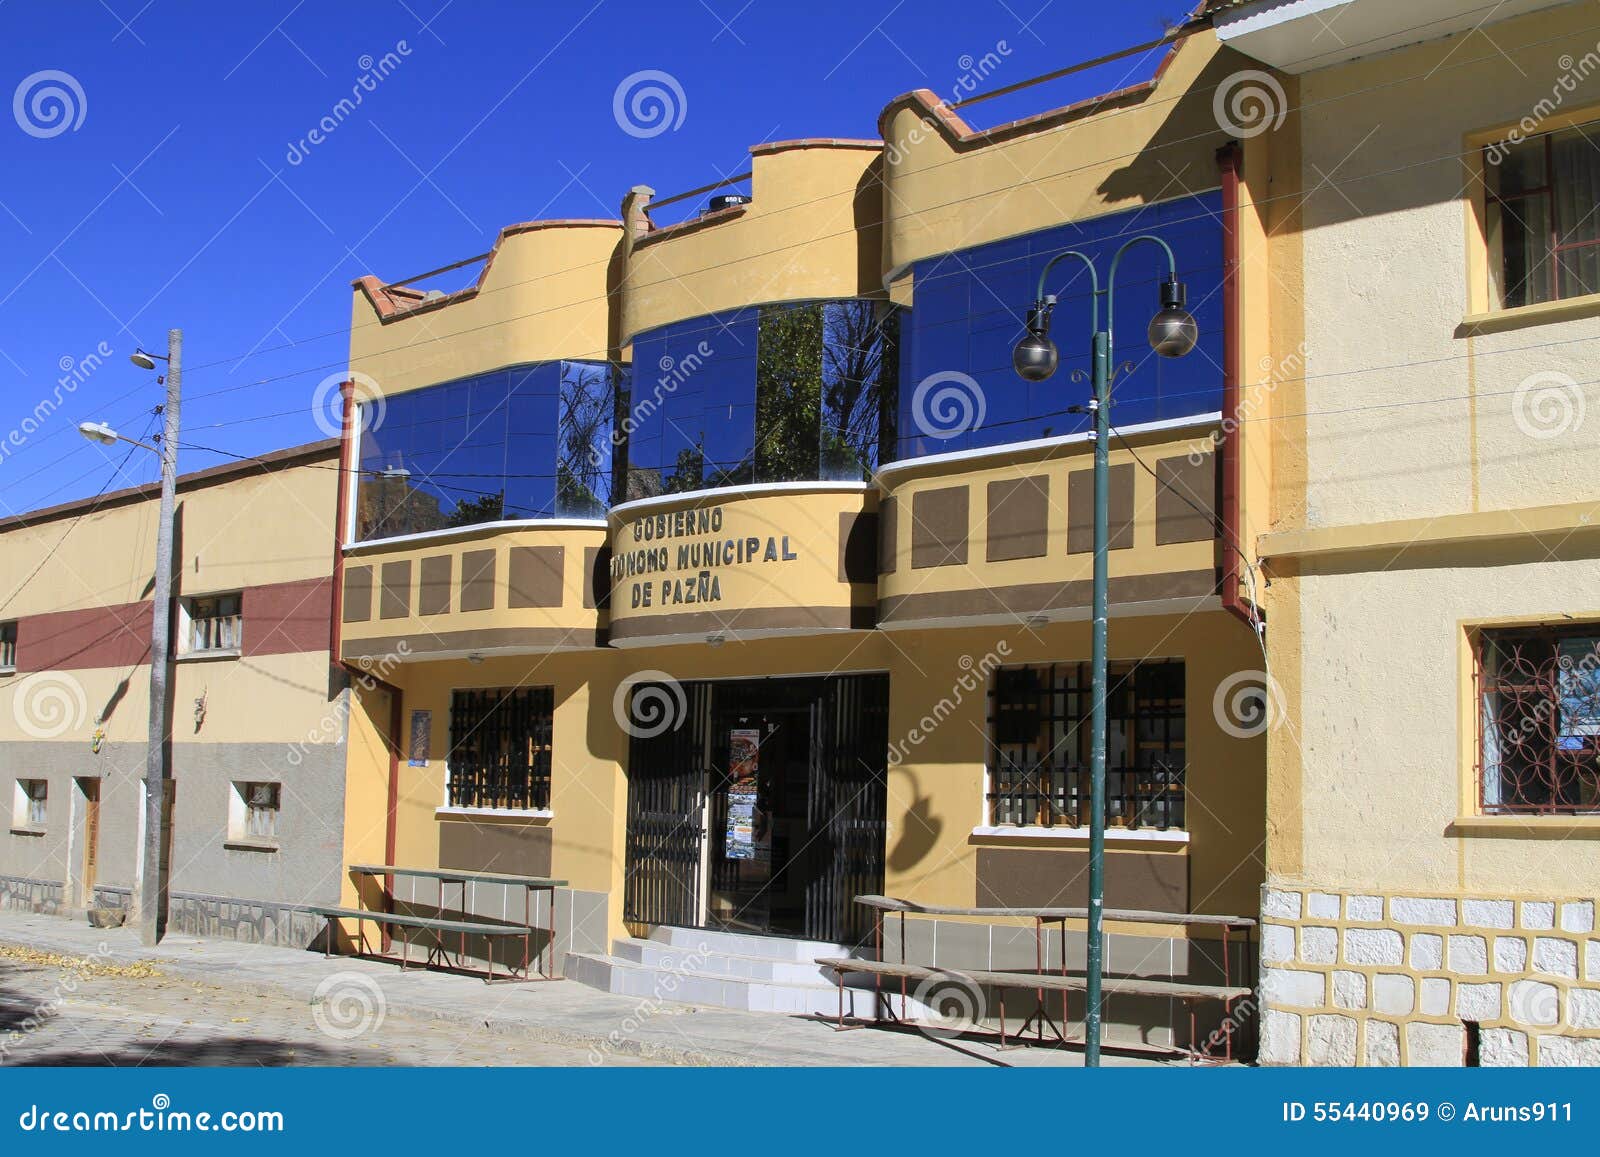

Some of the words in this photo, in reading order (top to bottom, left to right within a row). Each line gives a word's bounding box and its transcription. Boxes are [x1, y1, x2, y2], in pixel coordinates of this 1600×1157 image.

[633, 507, 723, 542] GOBIERNO
[677, 536, 798, 570] MUNICIPAL
[631, 582, 653, 609] DE
[661, 570, 721, 605] PAZÑA
